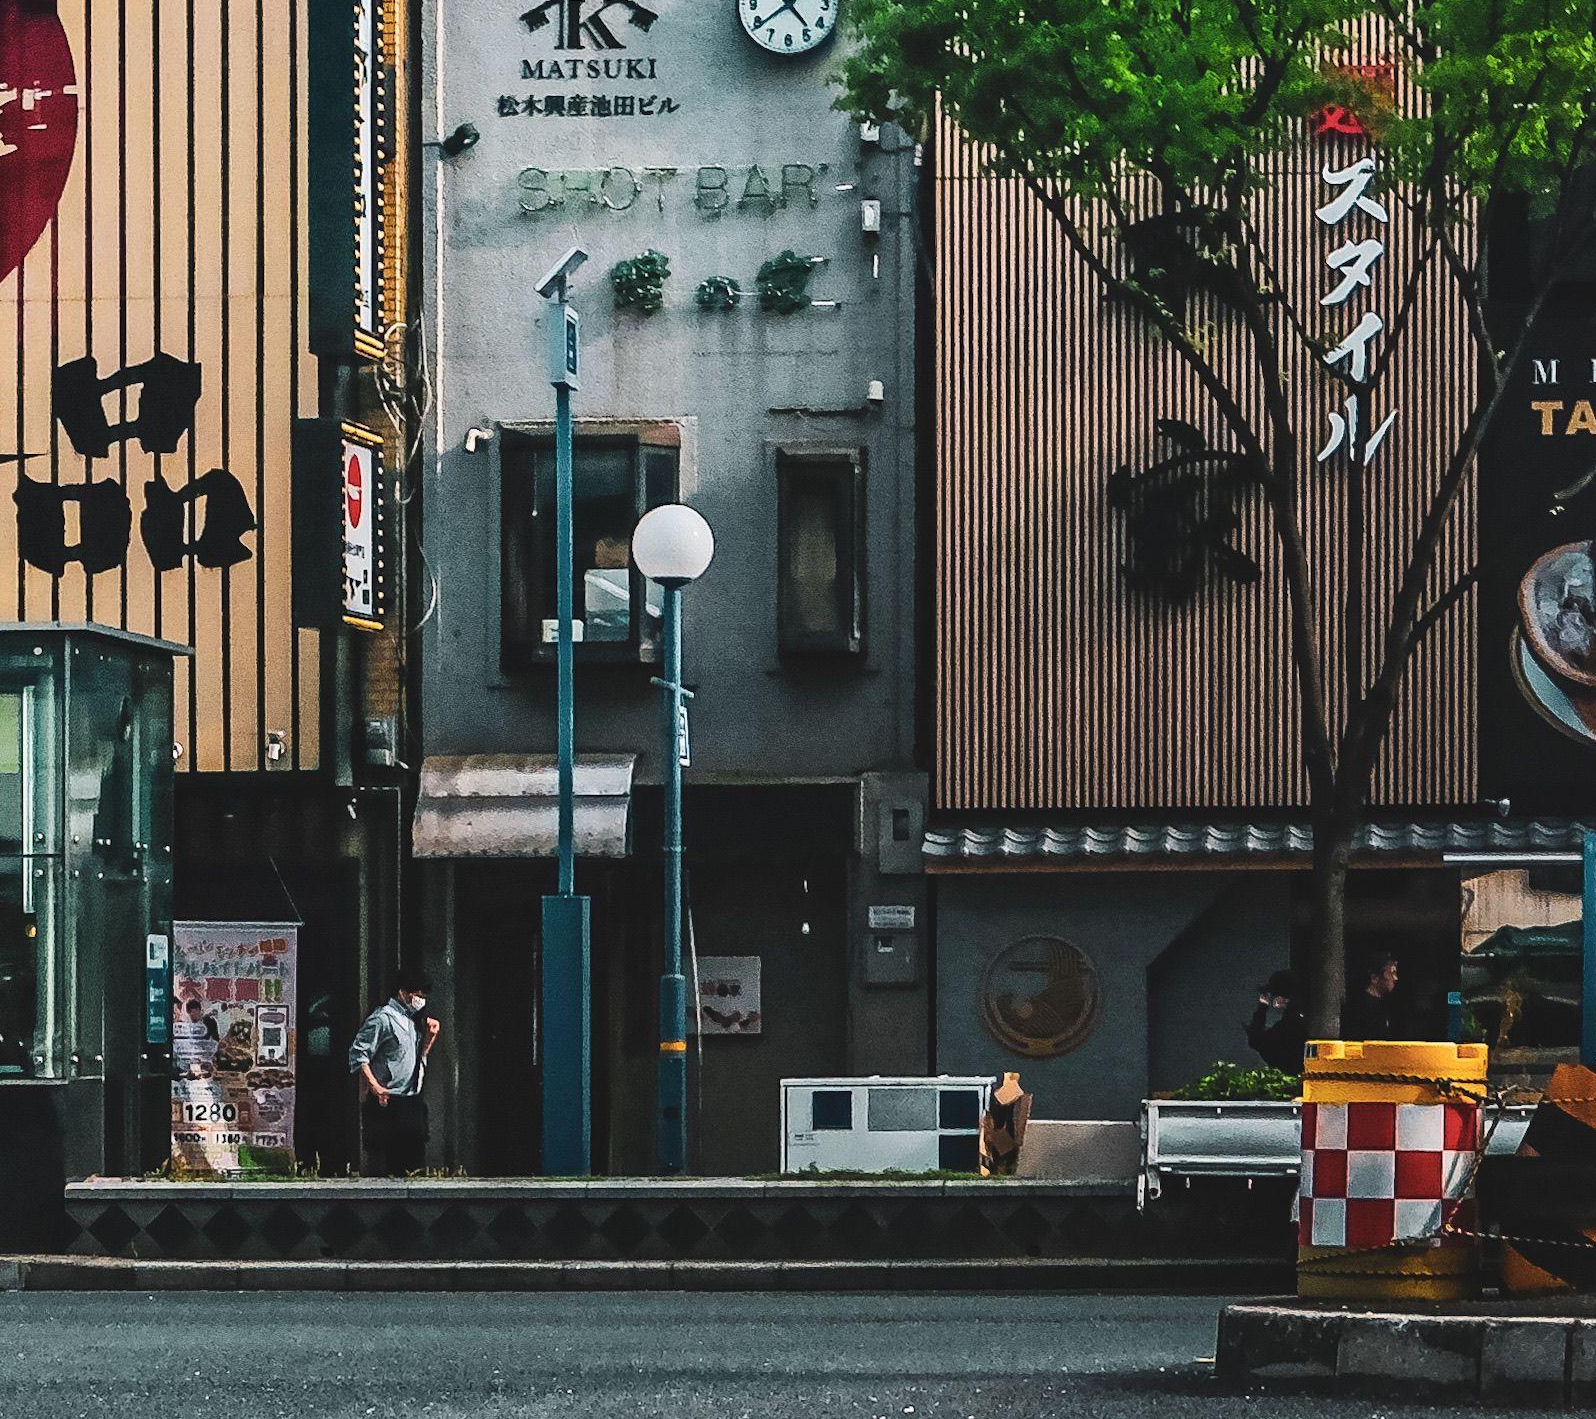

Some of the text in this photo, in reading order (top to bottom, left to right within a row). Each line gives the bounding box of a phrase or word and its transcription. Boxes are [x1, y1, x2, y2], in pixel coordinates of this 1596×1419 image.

[553, 0, 628, 50] K
[520, 58, 658, 80] MATSUKI
[496, 93, 681, 117] 松木興産池田ビル
[694, 164, 820, 217] BAR
[185, 1103, 237, 1123] 1280
